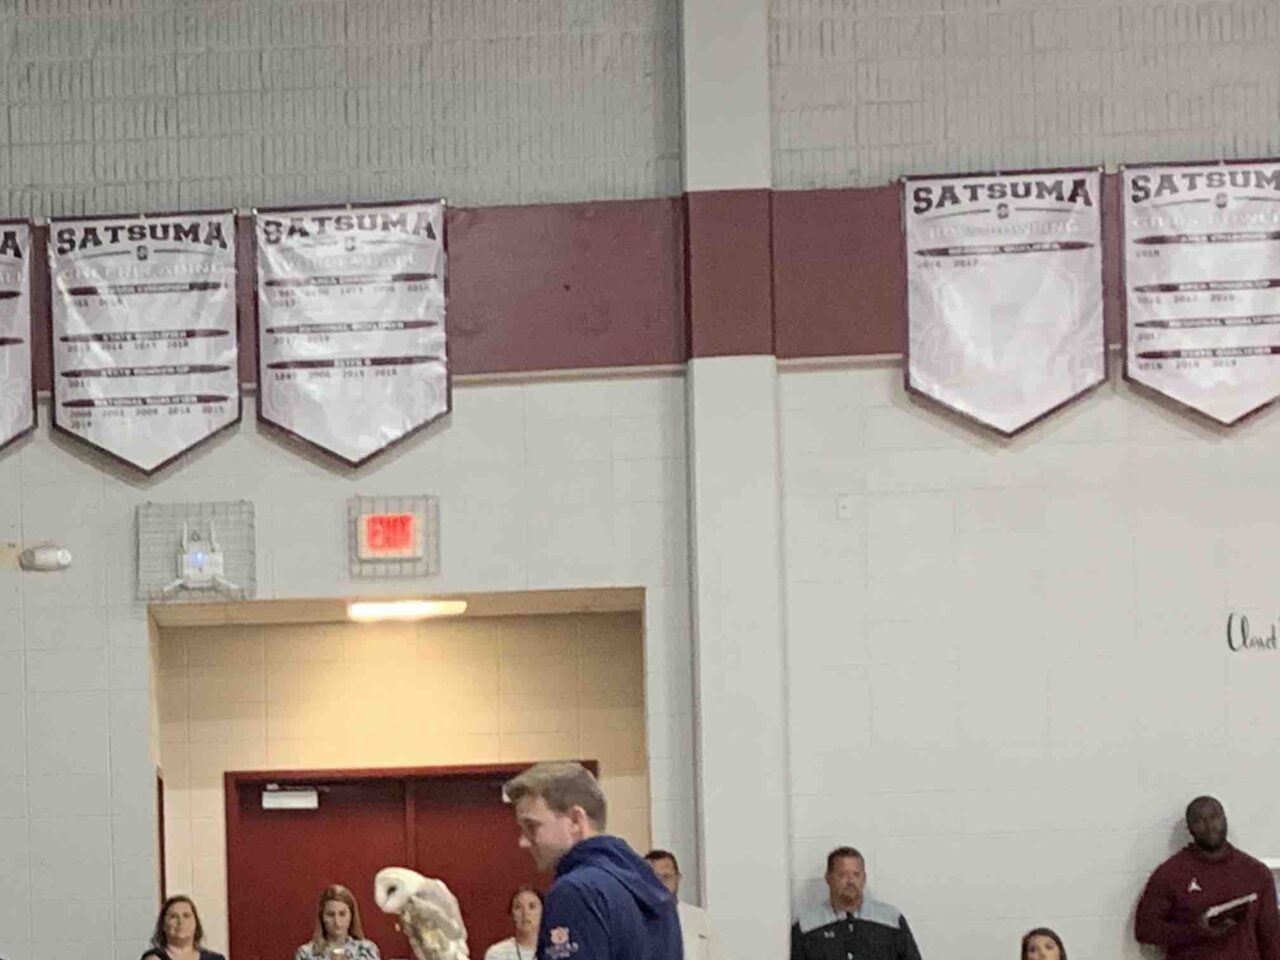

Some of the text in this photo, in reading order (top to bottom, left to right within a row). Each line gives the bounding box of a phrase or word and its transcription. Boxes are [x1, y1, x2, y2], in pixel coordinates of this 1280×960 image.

[913, 178, 1093, 215] SATSUMA
[56, 221, 228, 256] SATSUMA
[262, 211, 437, 245] SATSUMA
